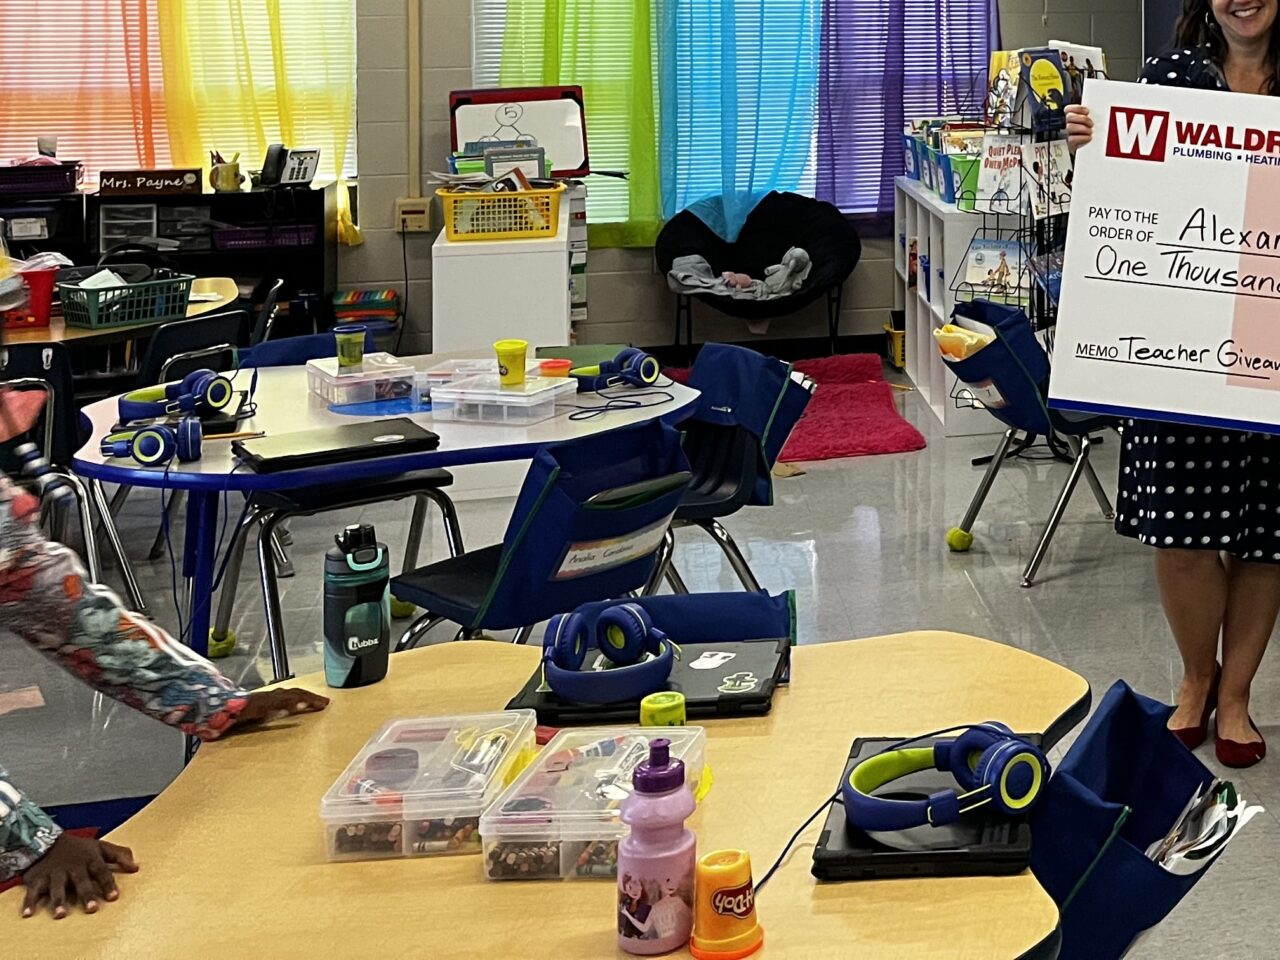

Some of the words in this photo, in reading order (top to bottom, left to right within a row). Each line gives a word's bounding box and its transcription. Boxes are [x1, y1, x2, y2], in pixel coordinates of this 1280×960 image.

[504, 106, 518, 118] 5
[1112, 111, 1165, 156] W
[1172, 146, 1232, 162] PLUMBING
[101, 177, 132, 189] Mrs.
[136, 177, 184, 190] Payne
[1088, 206, 1112, 219] PAY
[1114, 209, 1132, 222] TO
[1133, 211, 1159, 225] THE
[1089, 226, 1134, 241] ORDER
[1137, 230, 1155, 242] OF
[1095, 244, 1149, 277] One
[1075, 342, 1119, 358] MEMO
[1118, 336, 1211, 365] Teacher
